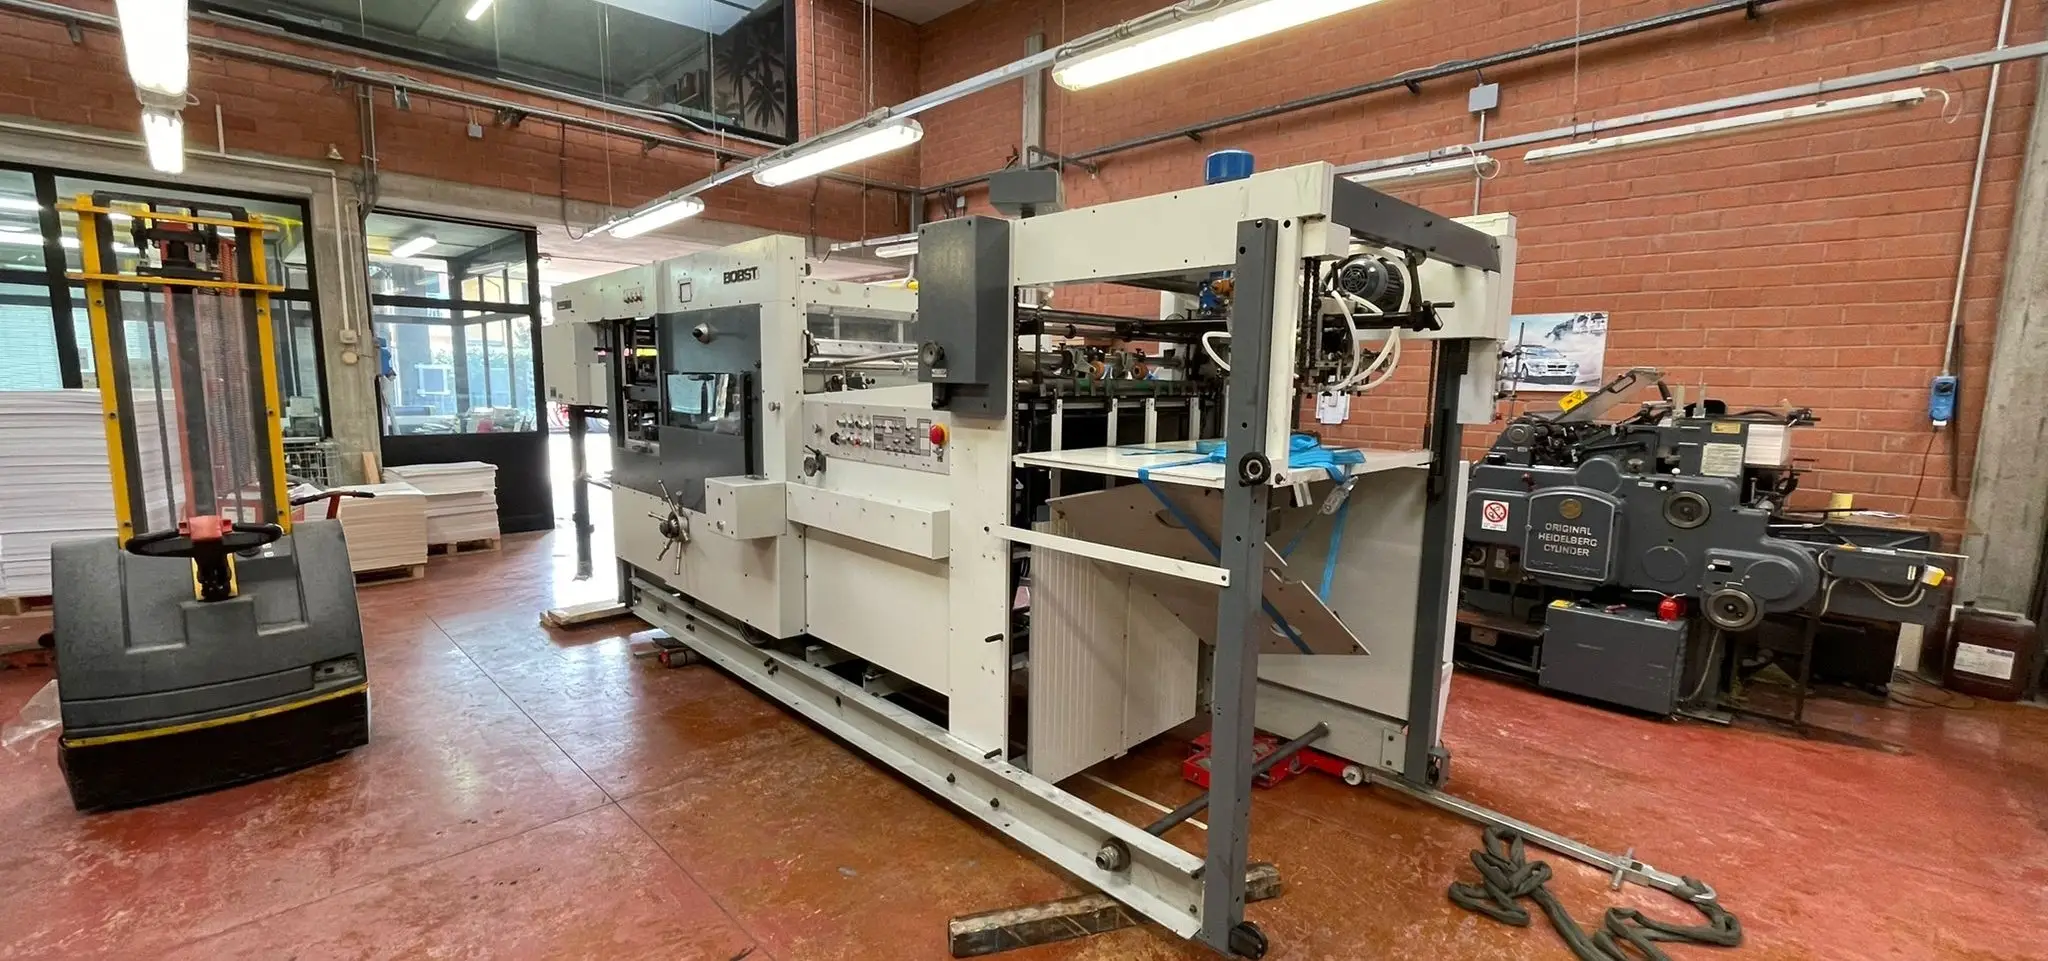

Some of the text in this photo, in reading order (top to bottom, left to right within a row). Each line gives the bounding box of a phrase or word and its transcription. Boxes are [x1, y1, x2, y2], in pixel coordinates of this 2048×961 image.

[723, 266, 758, 285] BOBST
[1545, 522, 1592, 536] ORIGINAL
[1538, 532, 1599, 547] HEIDELBERG
[1543, 543, 1590, 557] CYLINDER
